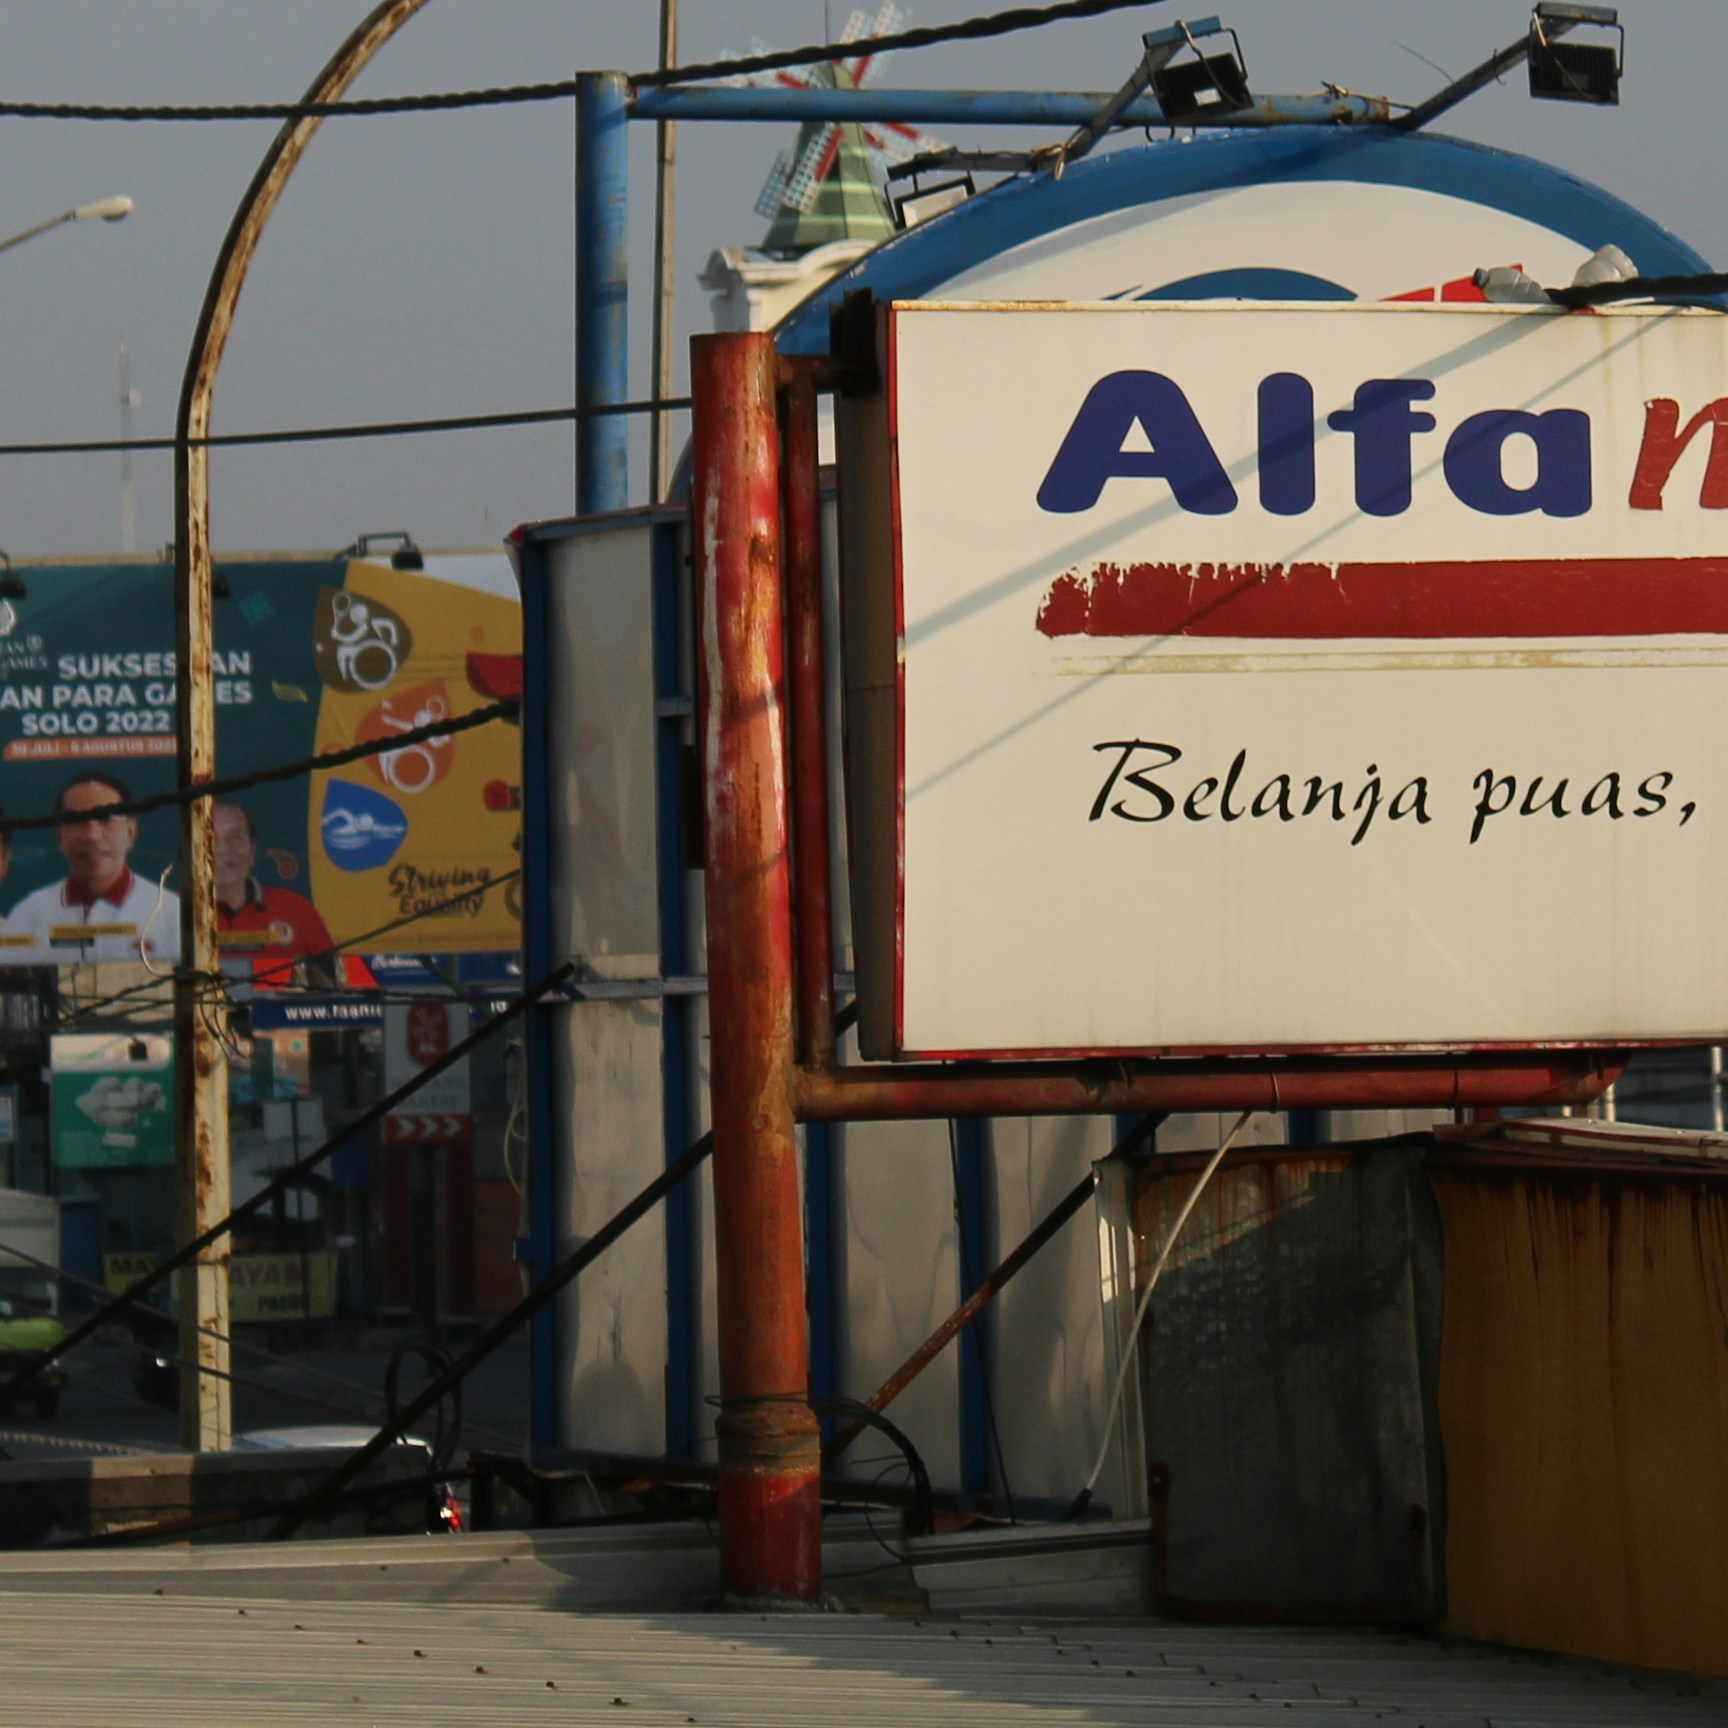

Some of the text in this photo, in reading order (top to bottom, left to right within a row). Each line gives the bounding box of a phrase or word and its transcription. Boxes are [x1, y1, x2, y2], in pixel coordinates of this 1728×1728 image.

[57, 652, 251, 680] SUKSESAN
[51, 683, 138, 709] PARA
[144, 681, 253, 706] GES
[22, 711, 170, 736] SOLO 2022
[1088, 738, 1432, 845] Belanja
[1469, 768, 1697, 845] puas,
